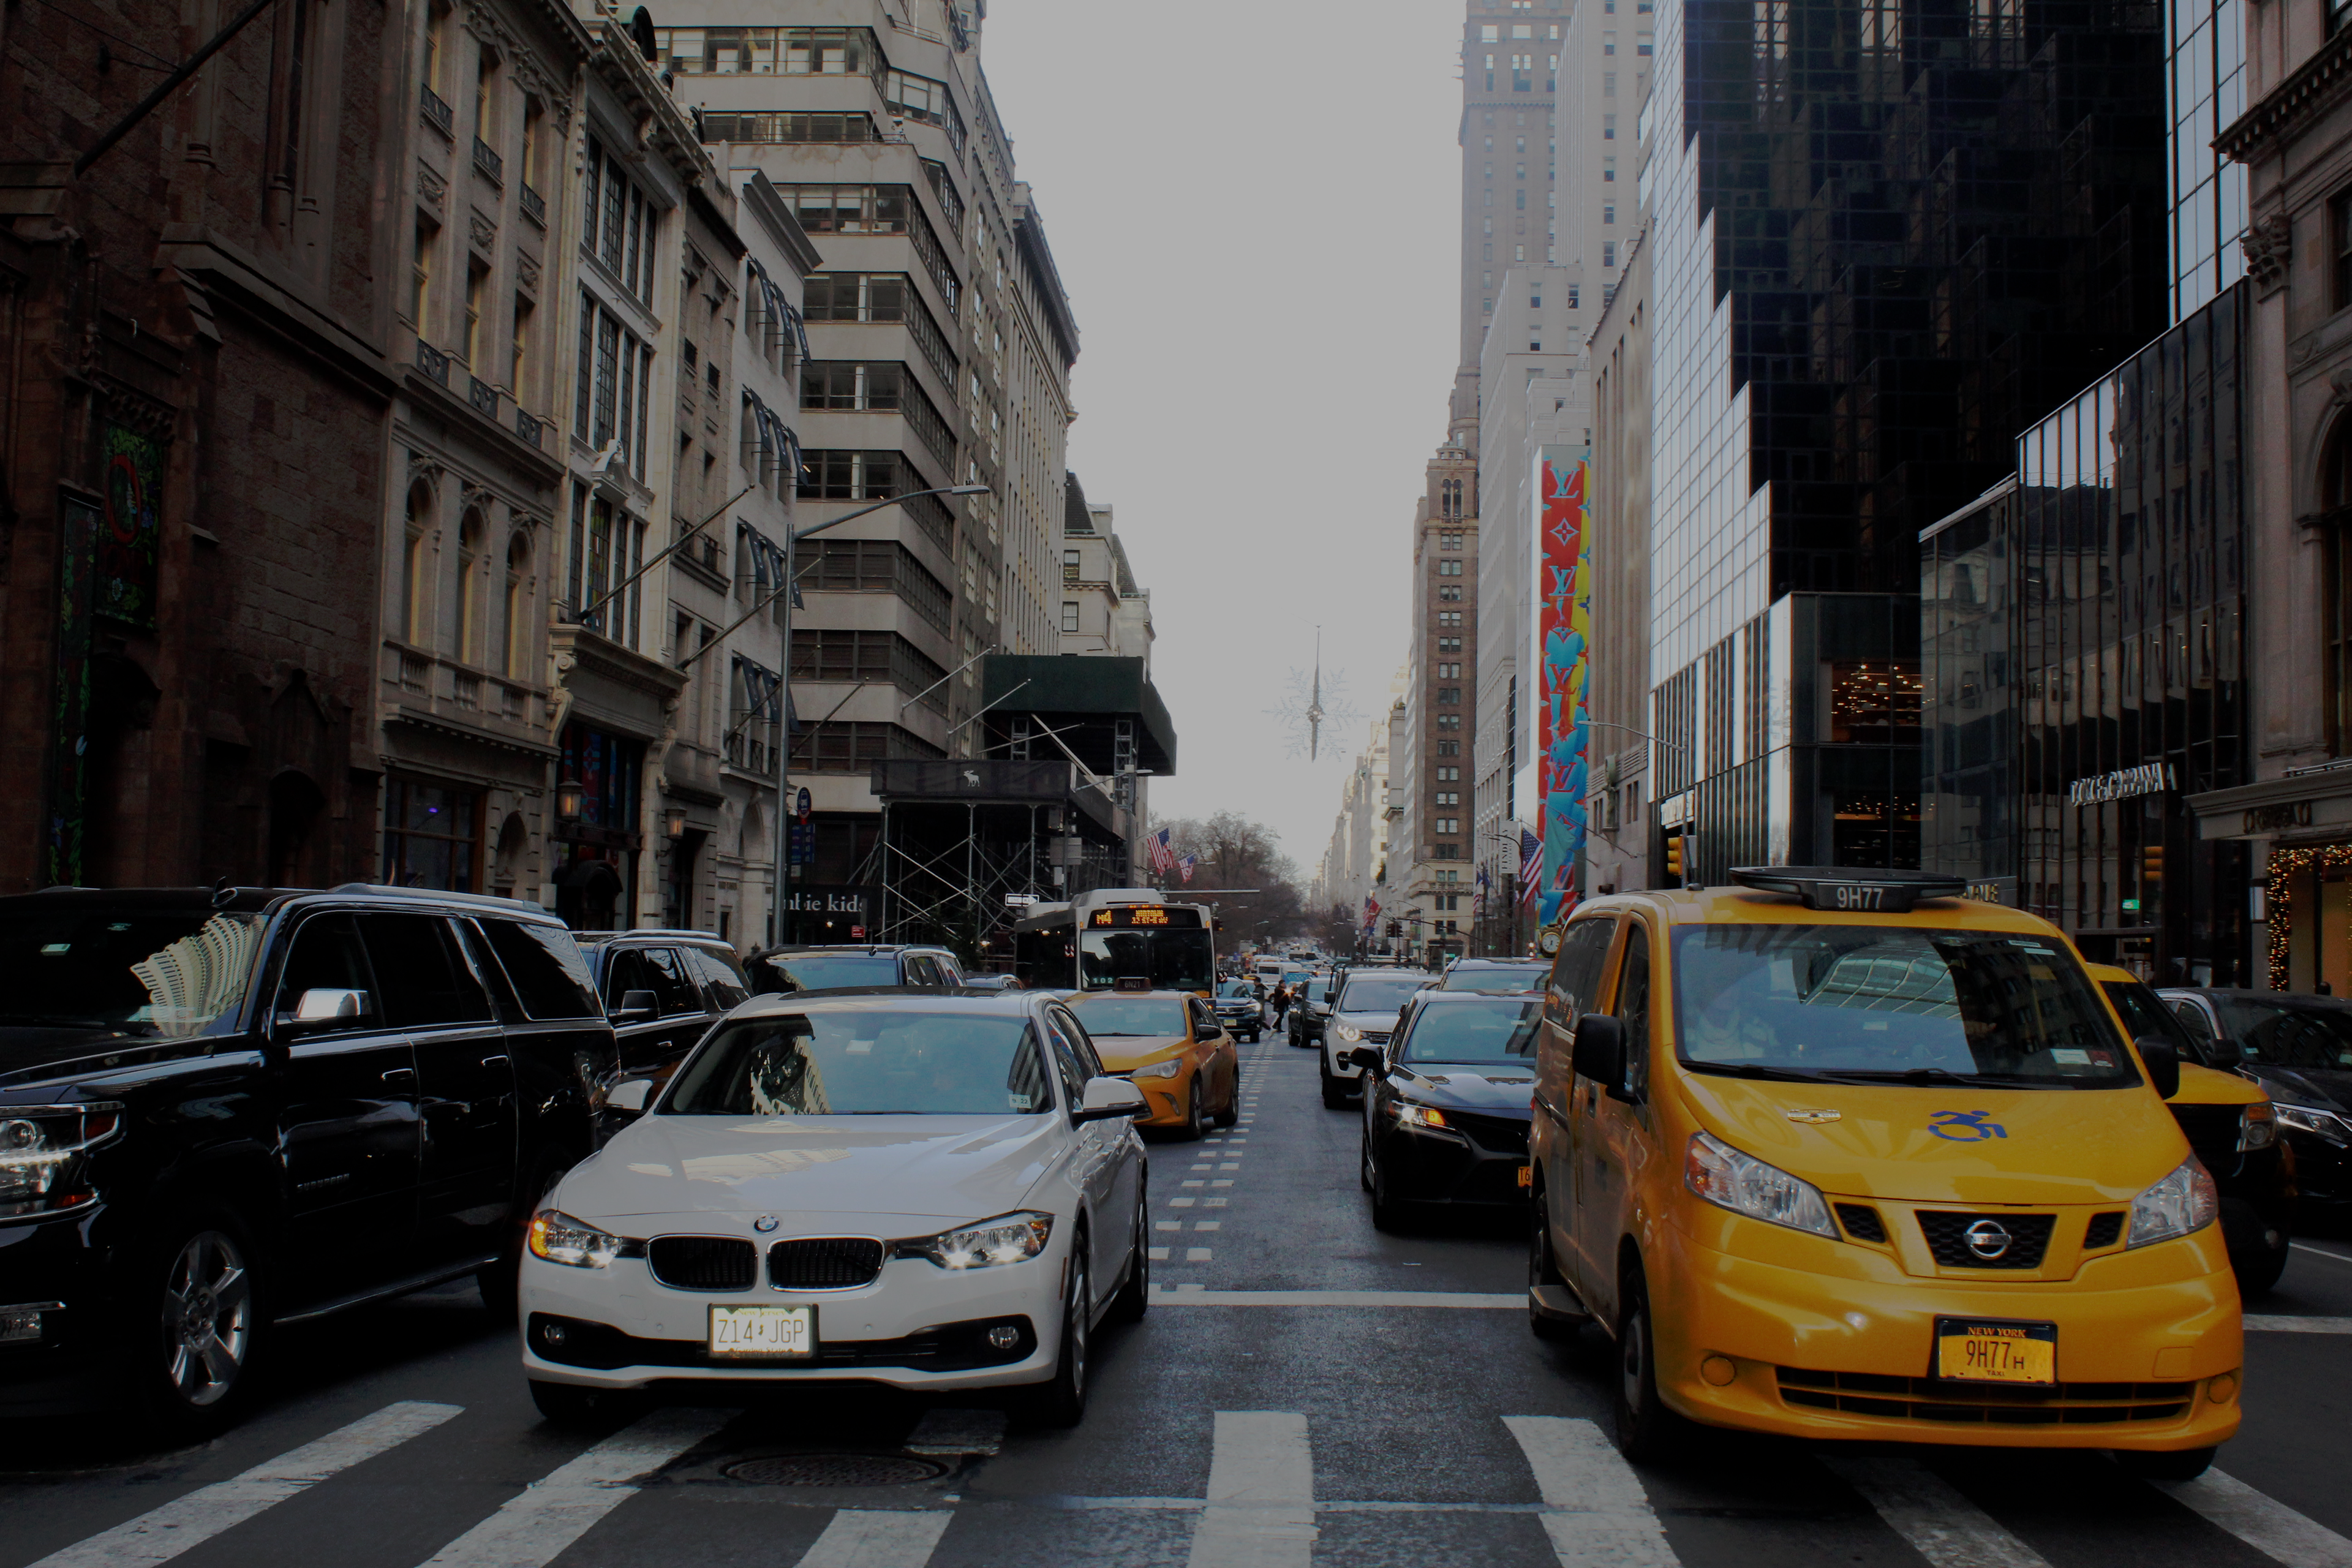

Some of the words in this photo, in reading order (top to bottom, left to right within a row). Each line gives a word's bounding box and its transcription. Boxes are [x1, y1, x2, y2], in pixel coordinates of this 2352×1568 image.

[1838, 886, 1885, 910] 9H77
[718, 1319, 753, 1343] Z14
[769, 1319, 804, 1343] JGP
[1968, 1326, 1995, 1336] NEW
[1996, 1327, 2027, 1338] YORK
[1966, 1340, 2011, 1369] 9H77
